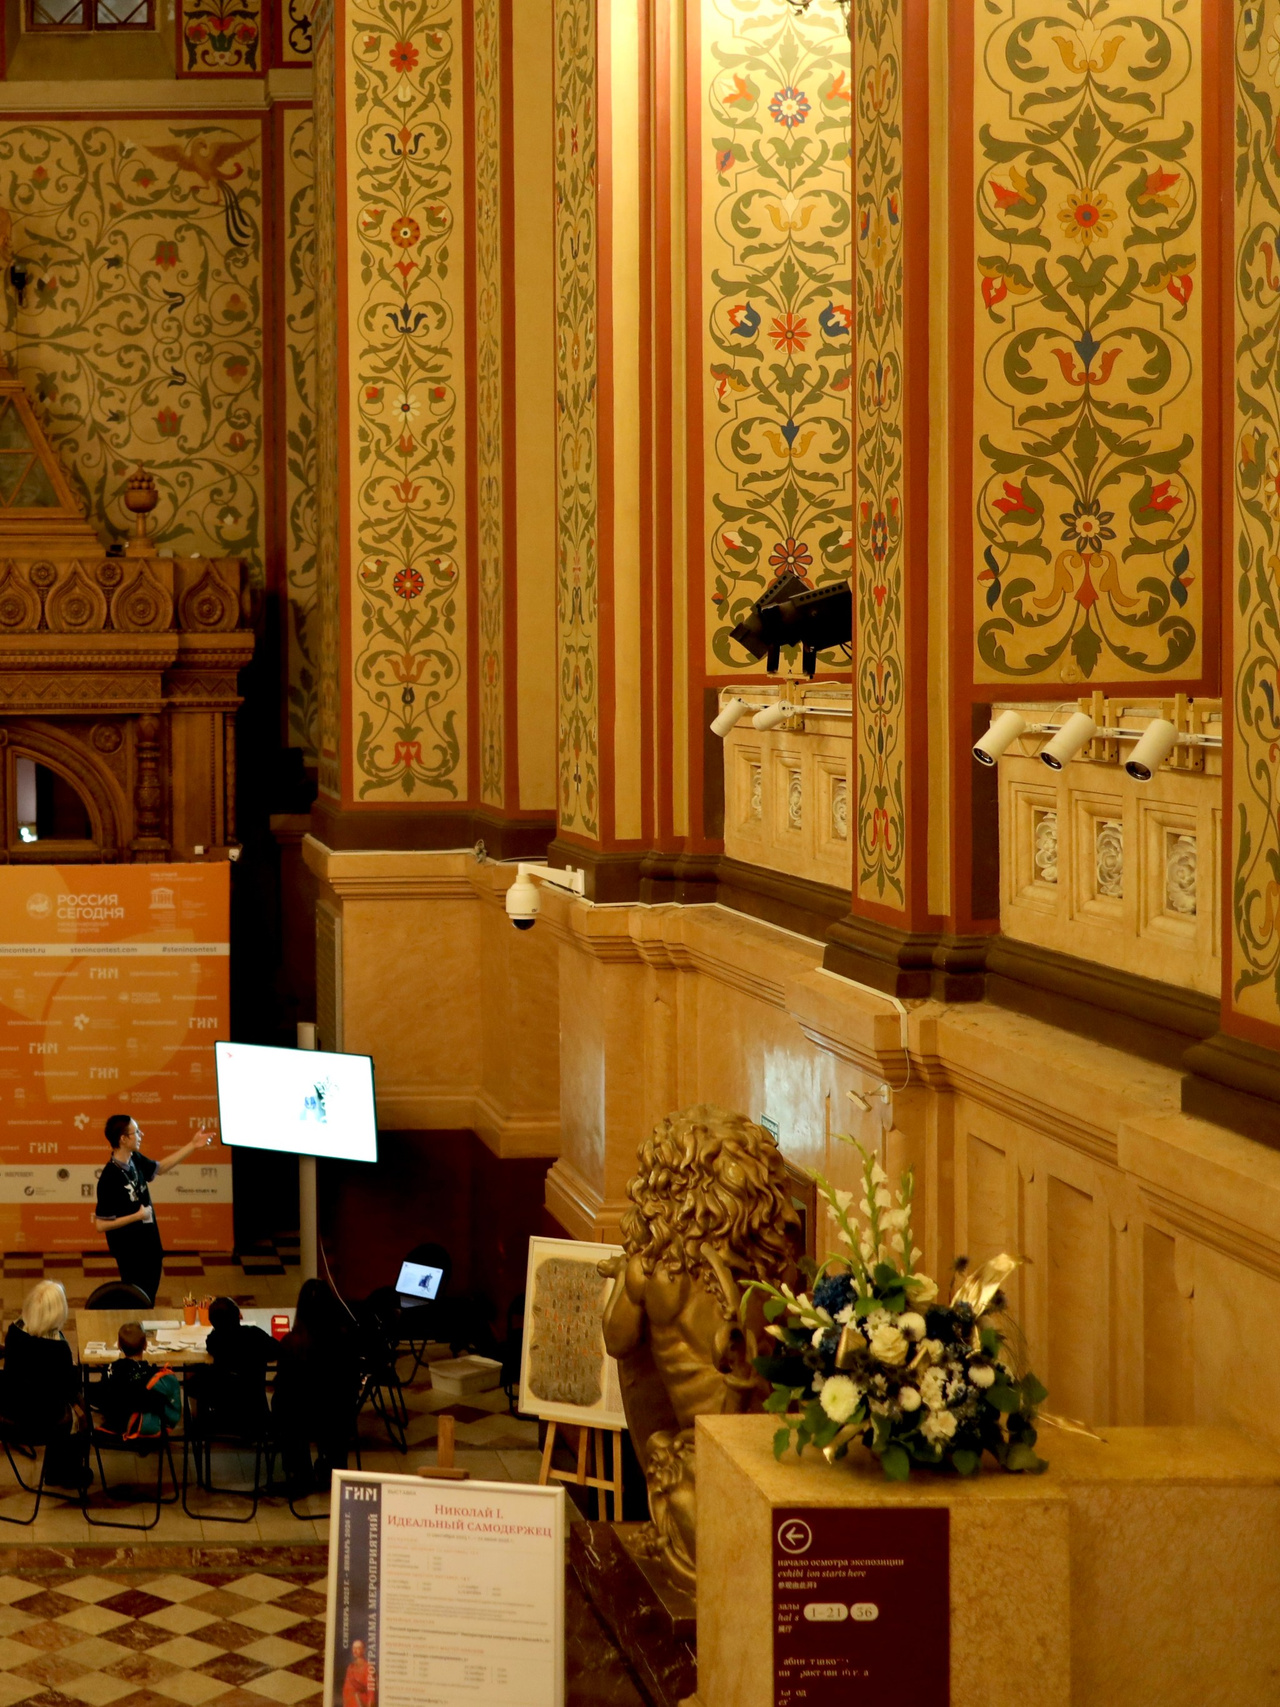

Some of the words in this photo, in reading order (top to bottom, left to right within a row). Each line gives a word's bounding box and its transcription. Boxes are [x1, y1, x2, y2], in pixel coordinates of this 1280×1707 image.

[57, 894, 118, 906] РОССИЯ
[57, 907, 125, 920] СЕГОДНЯ
[69, 946, 138, 954] stenincontest.com
[161, 945, 217, 953] #stenincontest
[344, 1486, 378, 1503] ГИМ
[466, 1522, 553, 1539] САМОДЕРЖЕЦ
[367, 1513, 379, 1610] МЕРОПРИЯТИЙ
[778, 1559, 809, 1567] начало
[811, 1559, 849, 1569] осмотра
[777, 1568, 821, 1578] exhibiion
[778, 1611, 800, 1622] hals
[366, 1612, 377, 1692] ПРОГРАММА
